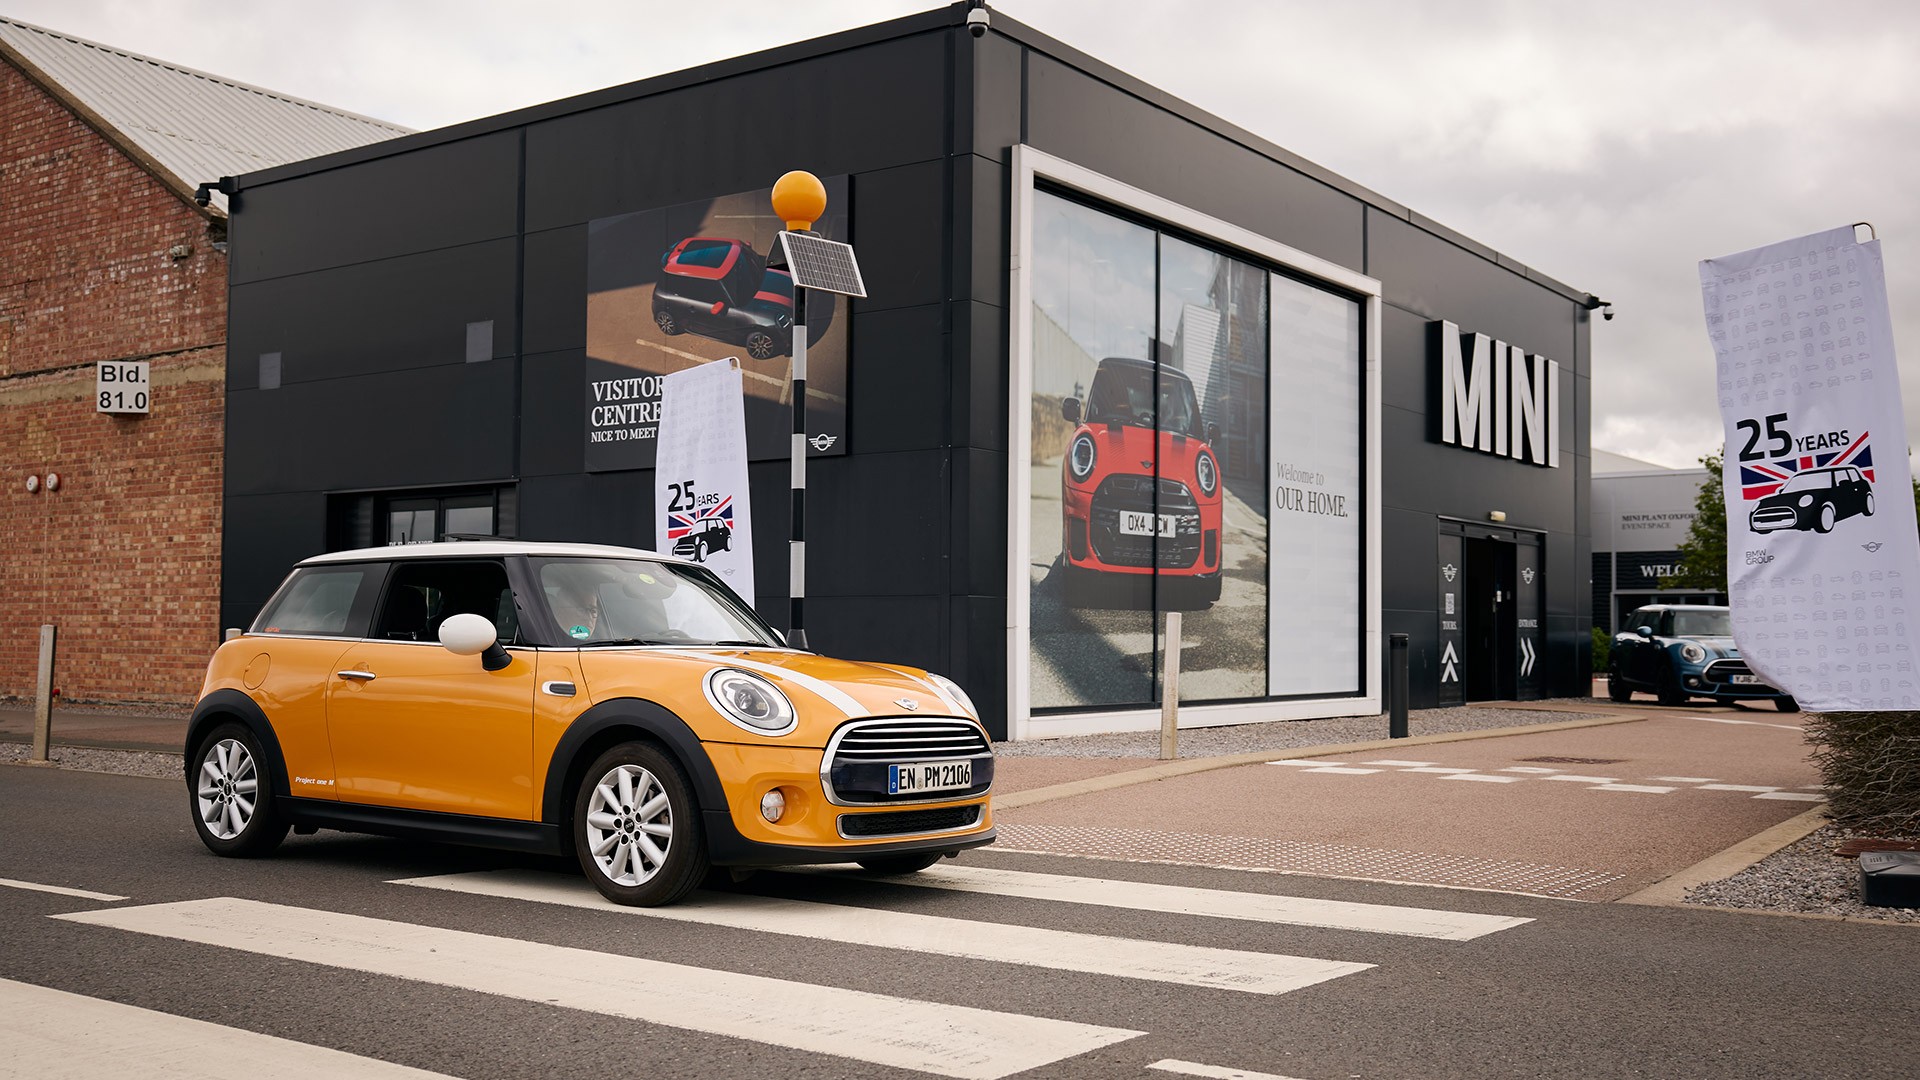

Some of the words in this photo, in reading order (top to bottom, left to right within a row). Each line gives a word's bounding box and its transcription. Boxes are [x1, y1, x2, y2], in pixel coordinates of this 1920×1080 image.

[101, 365, 146, 383] Bld.
[592, 375, 664, 401] VISITOR
[1442, 319, 1559, 468] MINI
[99, 391, 147, 409] 81.0
[591, 401, 662, 427] CENTRE
[591, 432, 614, 443] NICE
[615, 430, 628, 441] TO
[630, 427, 656, 440] MEET
[1737, 413, 1793, 462] 25
[1796, 430, 1850, 453] YEARS
[1277, 463, 1314, 484] Welcome
[1316, 473, 1325, 486] to
[668, 480, 696, 512] 25
[697, 493, 719, 506] EARS
[1276, 486, 1304, 512] OUR
[1308, 491, 1348, 518] HOME.
[1128, 514, 1145, 532] OX4
[1746, 549, 1766, 557] BMW
[1746, 555, 1774, 565] GROUP
[1640, 564, 1690, 577] WELC
[295, 776, 316, 785] Project
[899, 768, 915, 790] EN
[924, 766, 940, 788] PM
[942, 764, 970, 786] 2106
